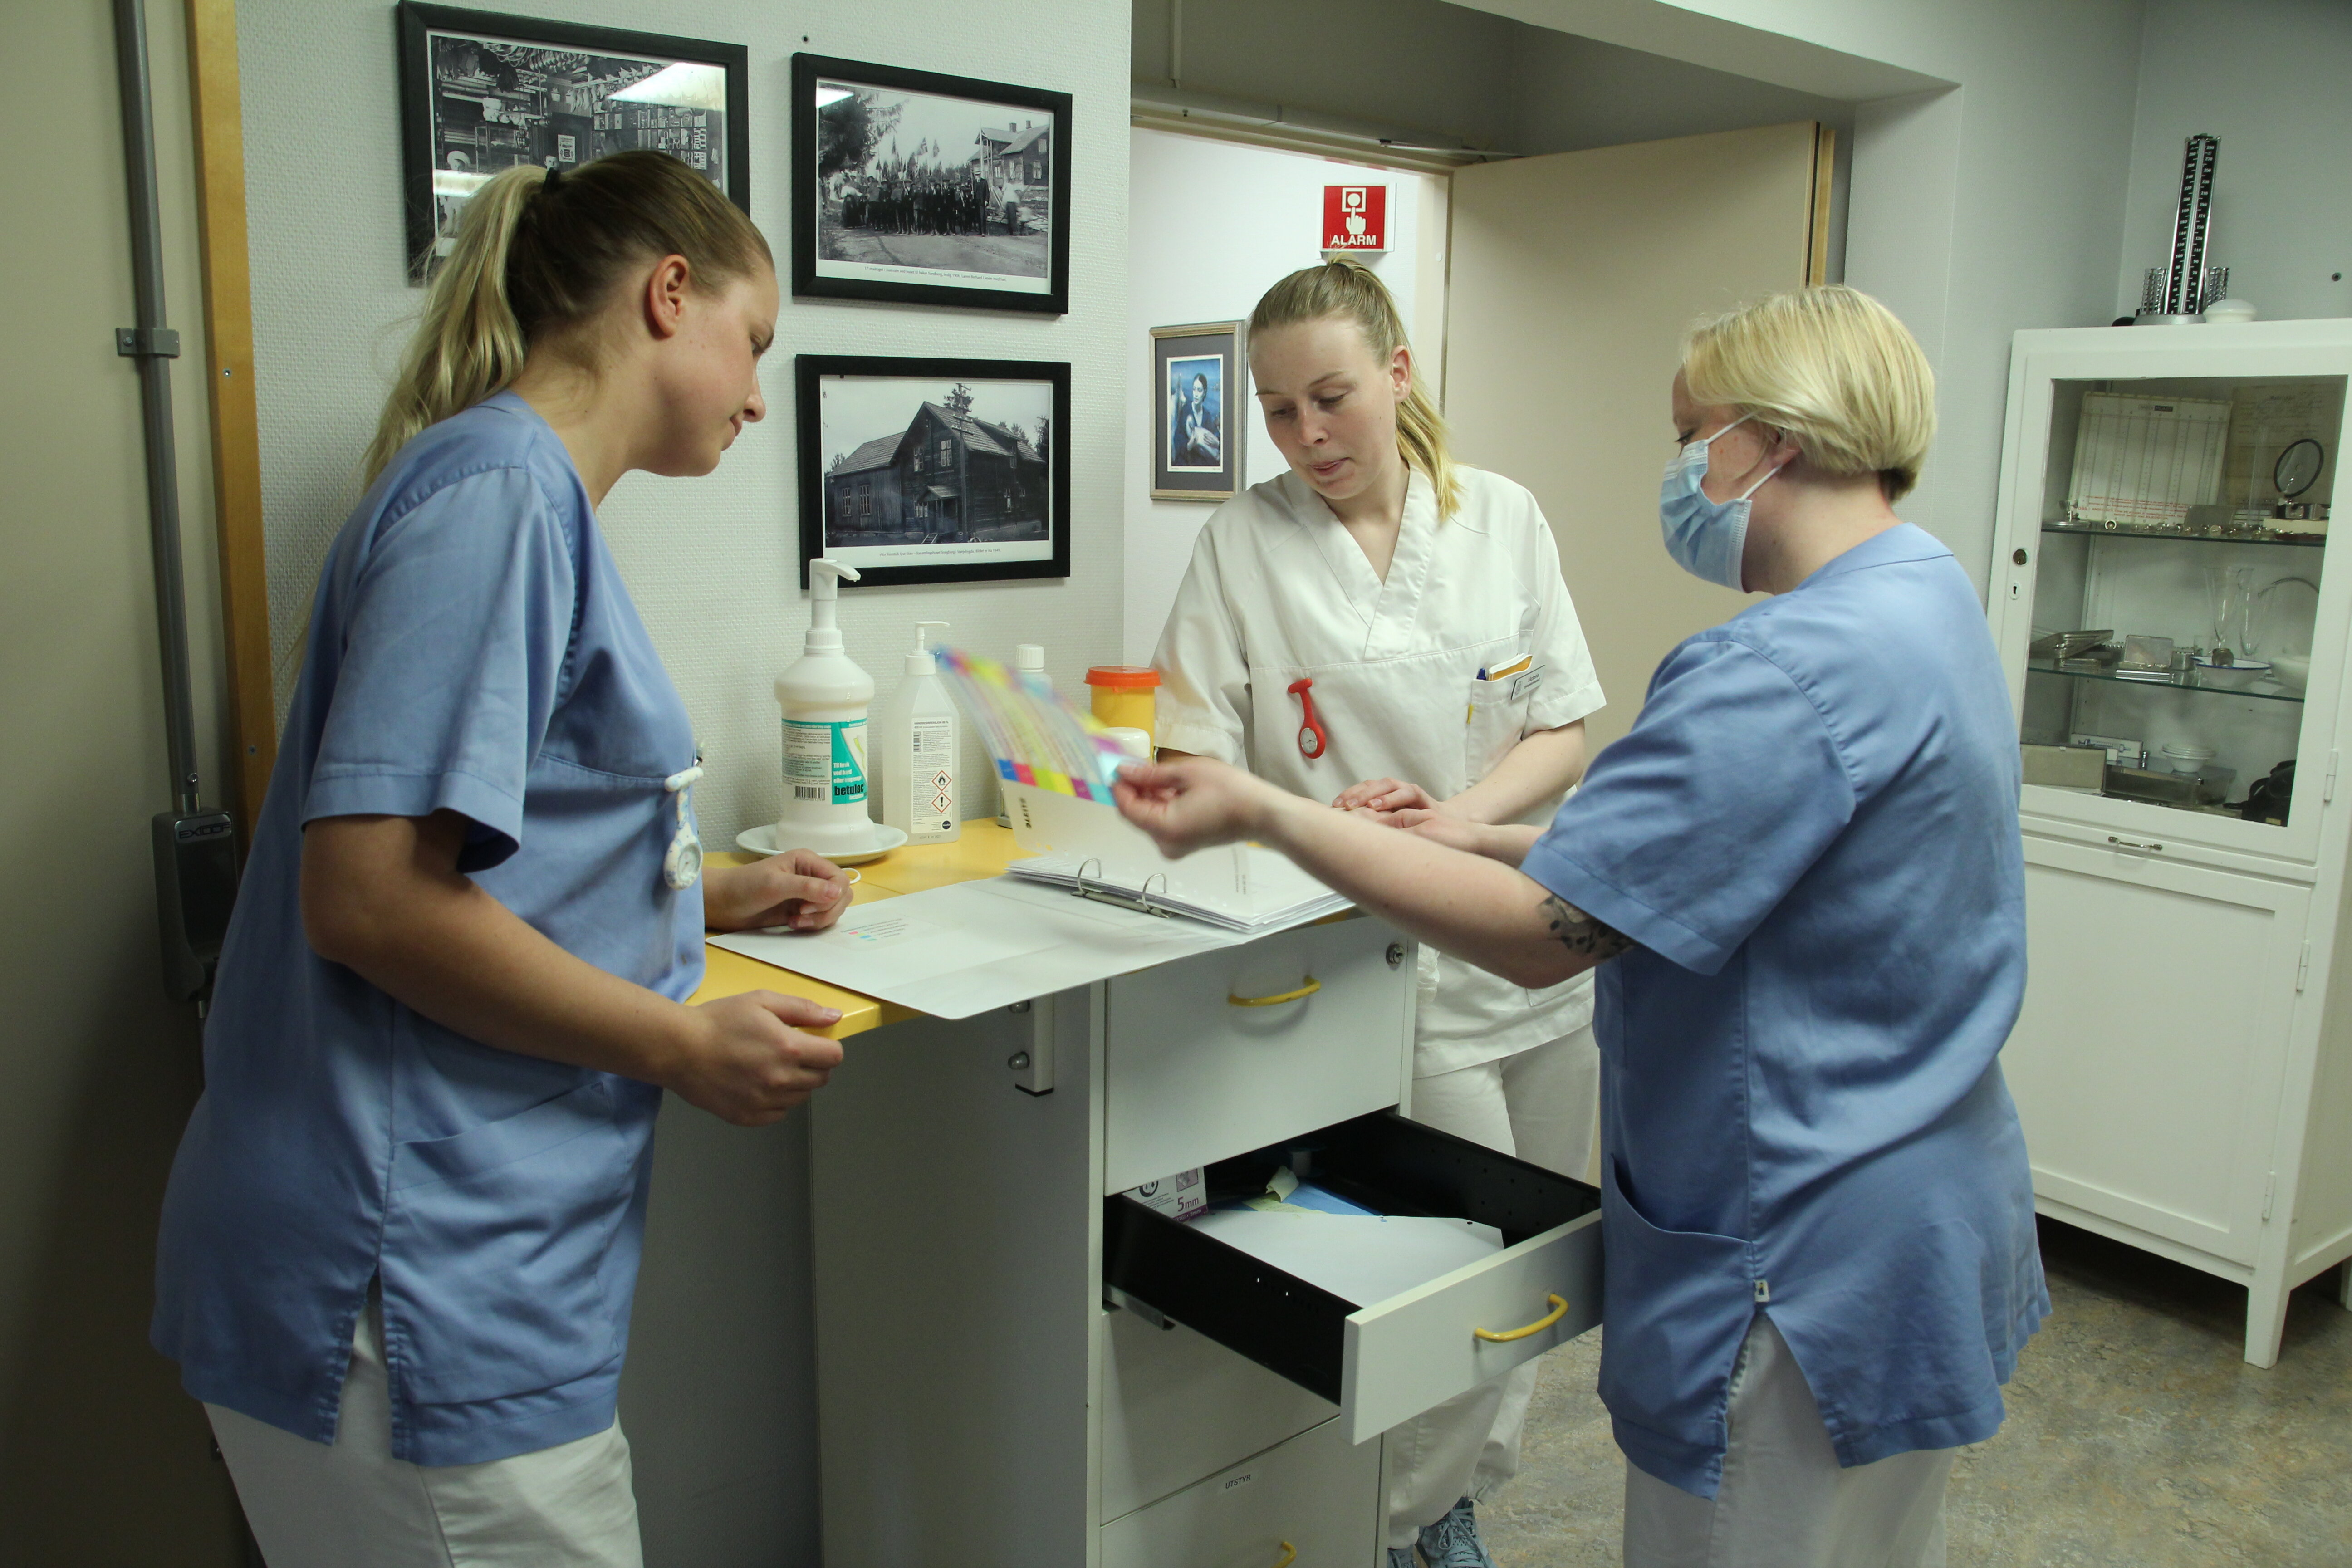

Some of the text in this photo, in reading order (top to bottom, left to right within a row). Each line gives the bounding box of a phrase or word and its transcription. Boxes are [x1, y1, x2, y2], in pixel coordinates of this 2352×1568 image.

[1331, 235, 1377, 245] ALARM
[834, 784, 864, 796] betulac
[1178, 1196, 1199, 1212] 5mm
[1225, 1474, 1251, 1489] UTSTYR
